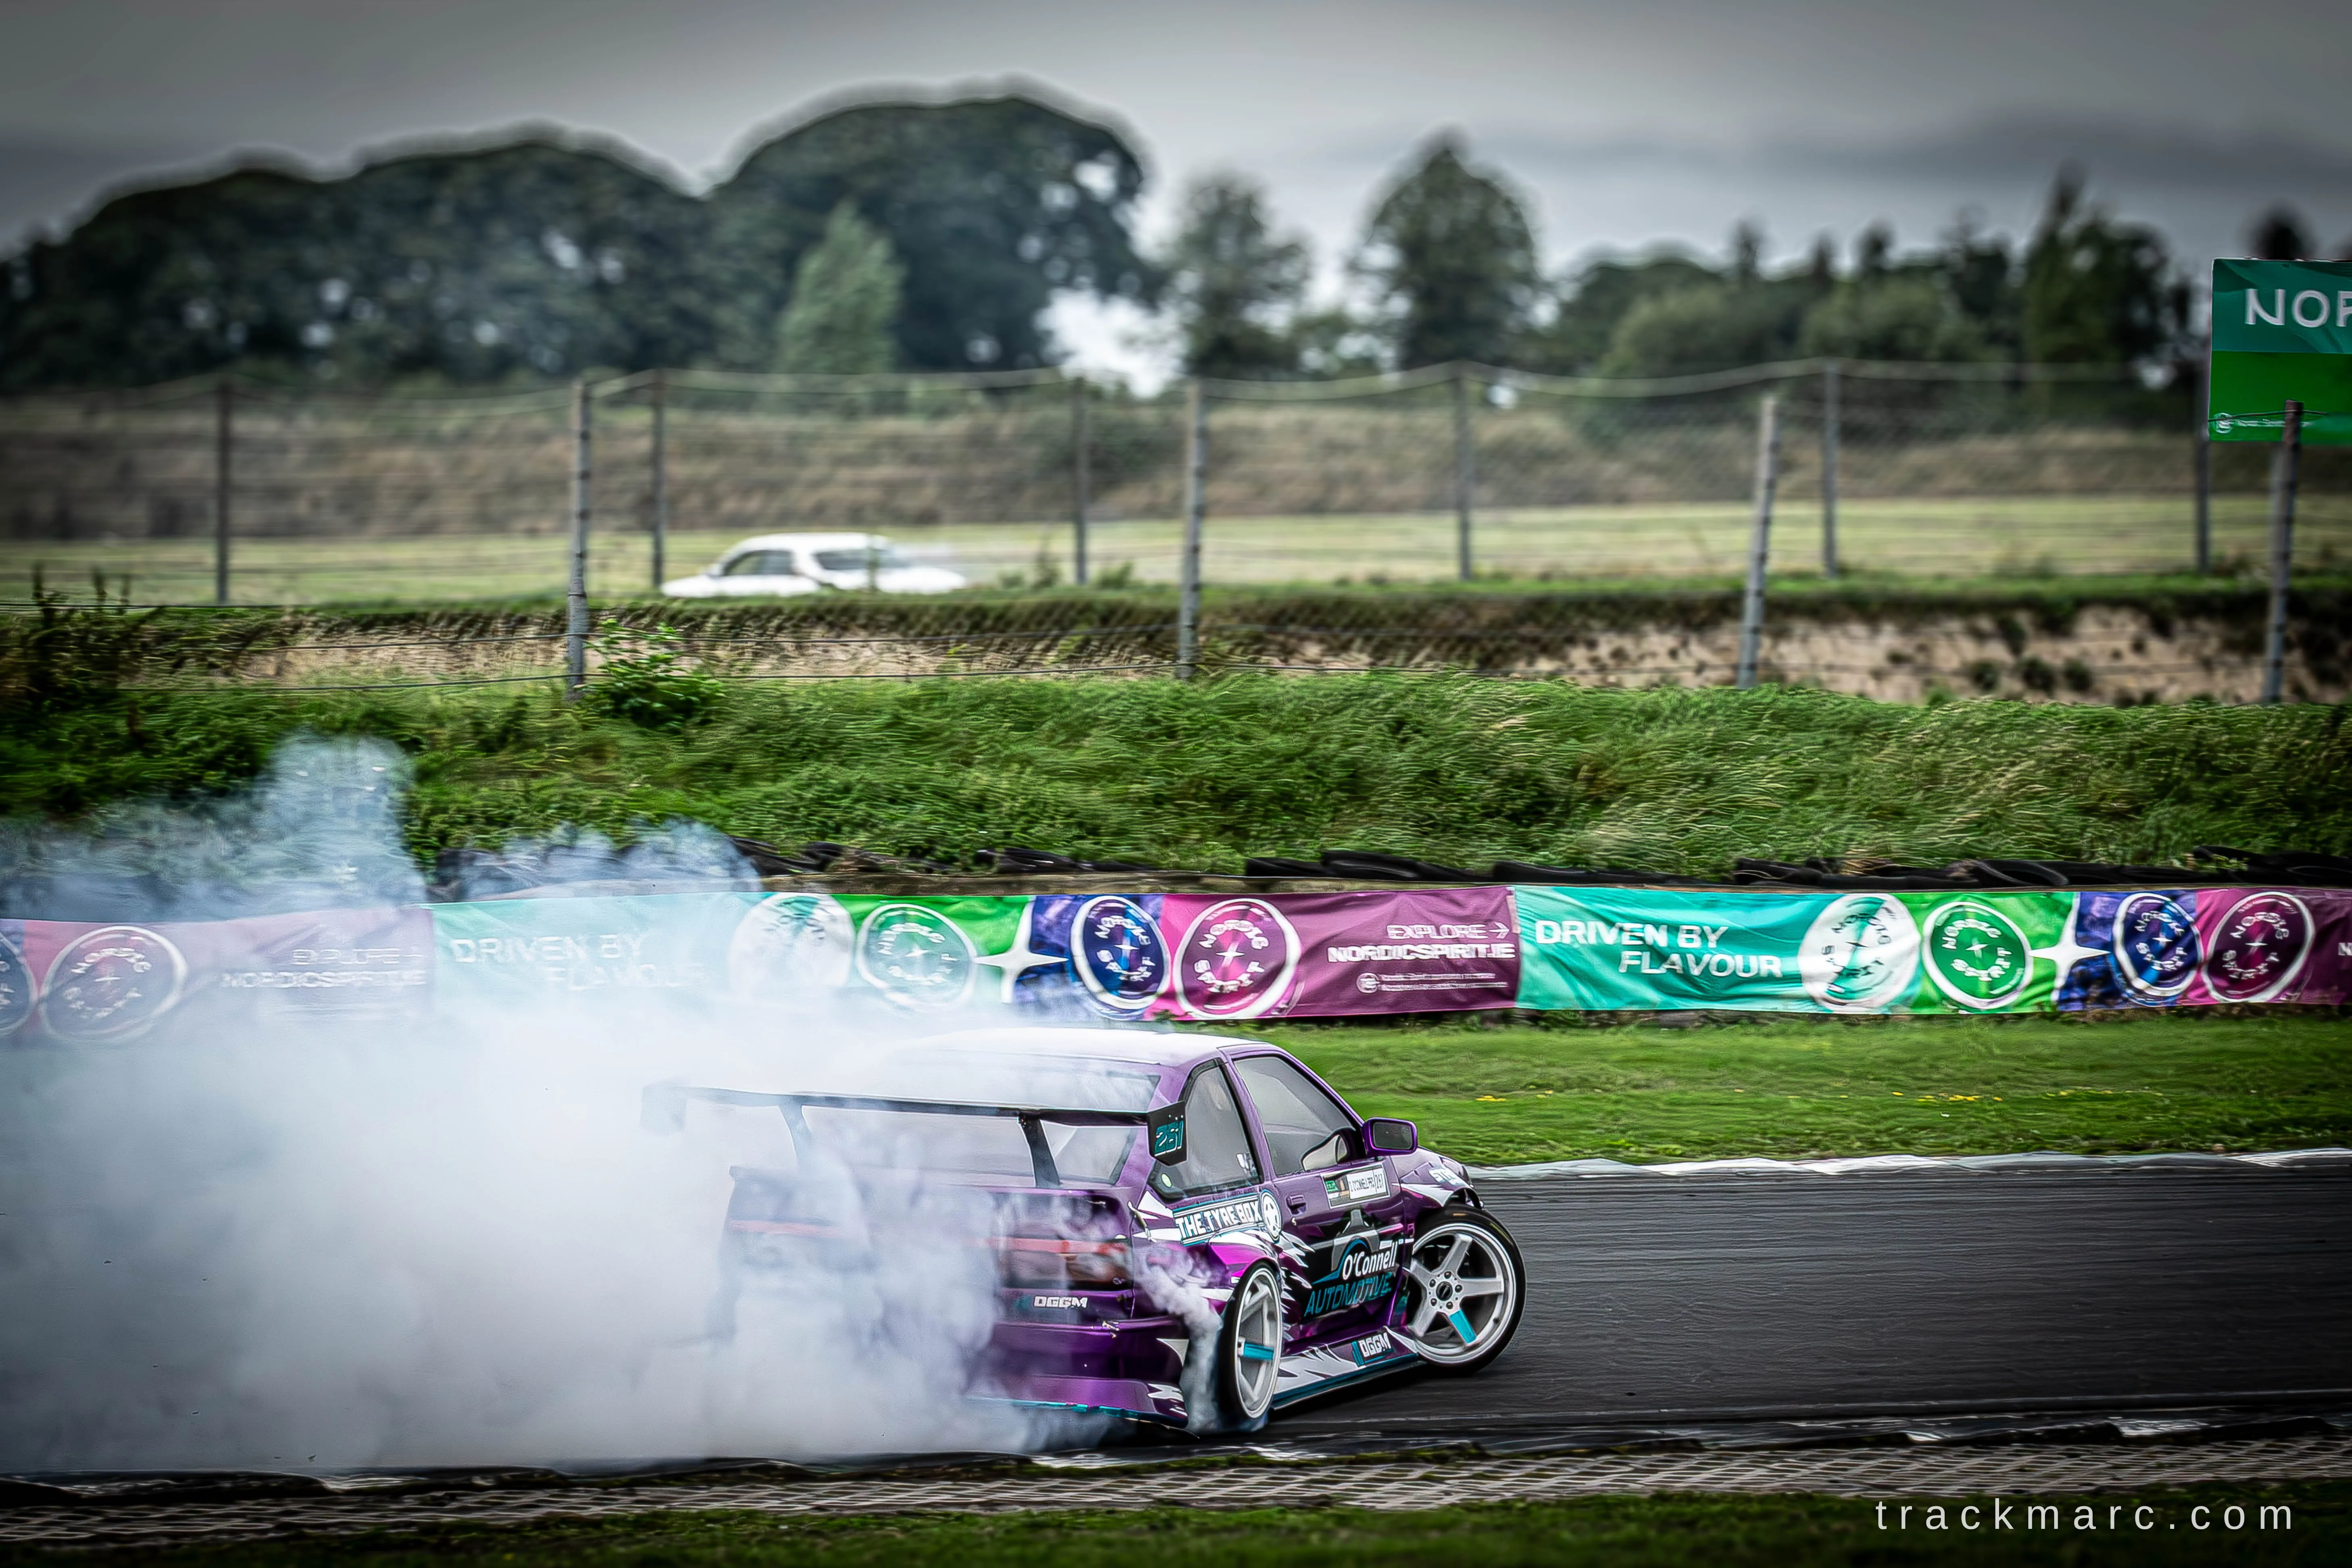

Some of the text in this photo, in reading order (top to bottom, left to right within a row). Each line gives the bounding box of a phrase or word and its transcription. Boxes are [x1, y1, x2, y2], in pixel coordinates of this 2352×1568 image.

[1387, 924, 1489, 939] EXPLORE
[1535, 920, 1729, 948] DRIVEN BY
[1618, 951, 1783, 978] FLAVOUR
[1175, 1201, 1263, 1239] THE TYRE BOX
[1342, 1241, 1398, 1280] O'Connell
[1303, 1272, 1393, 1317] AUTOMOTIVE
